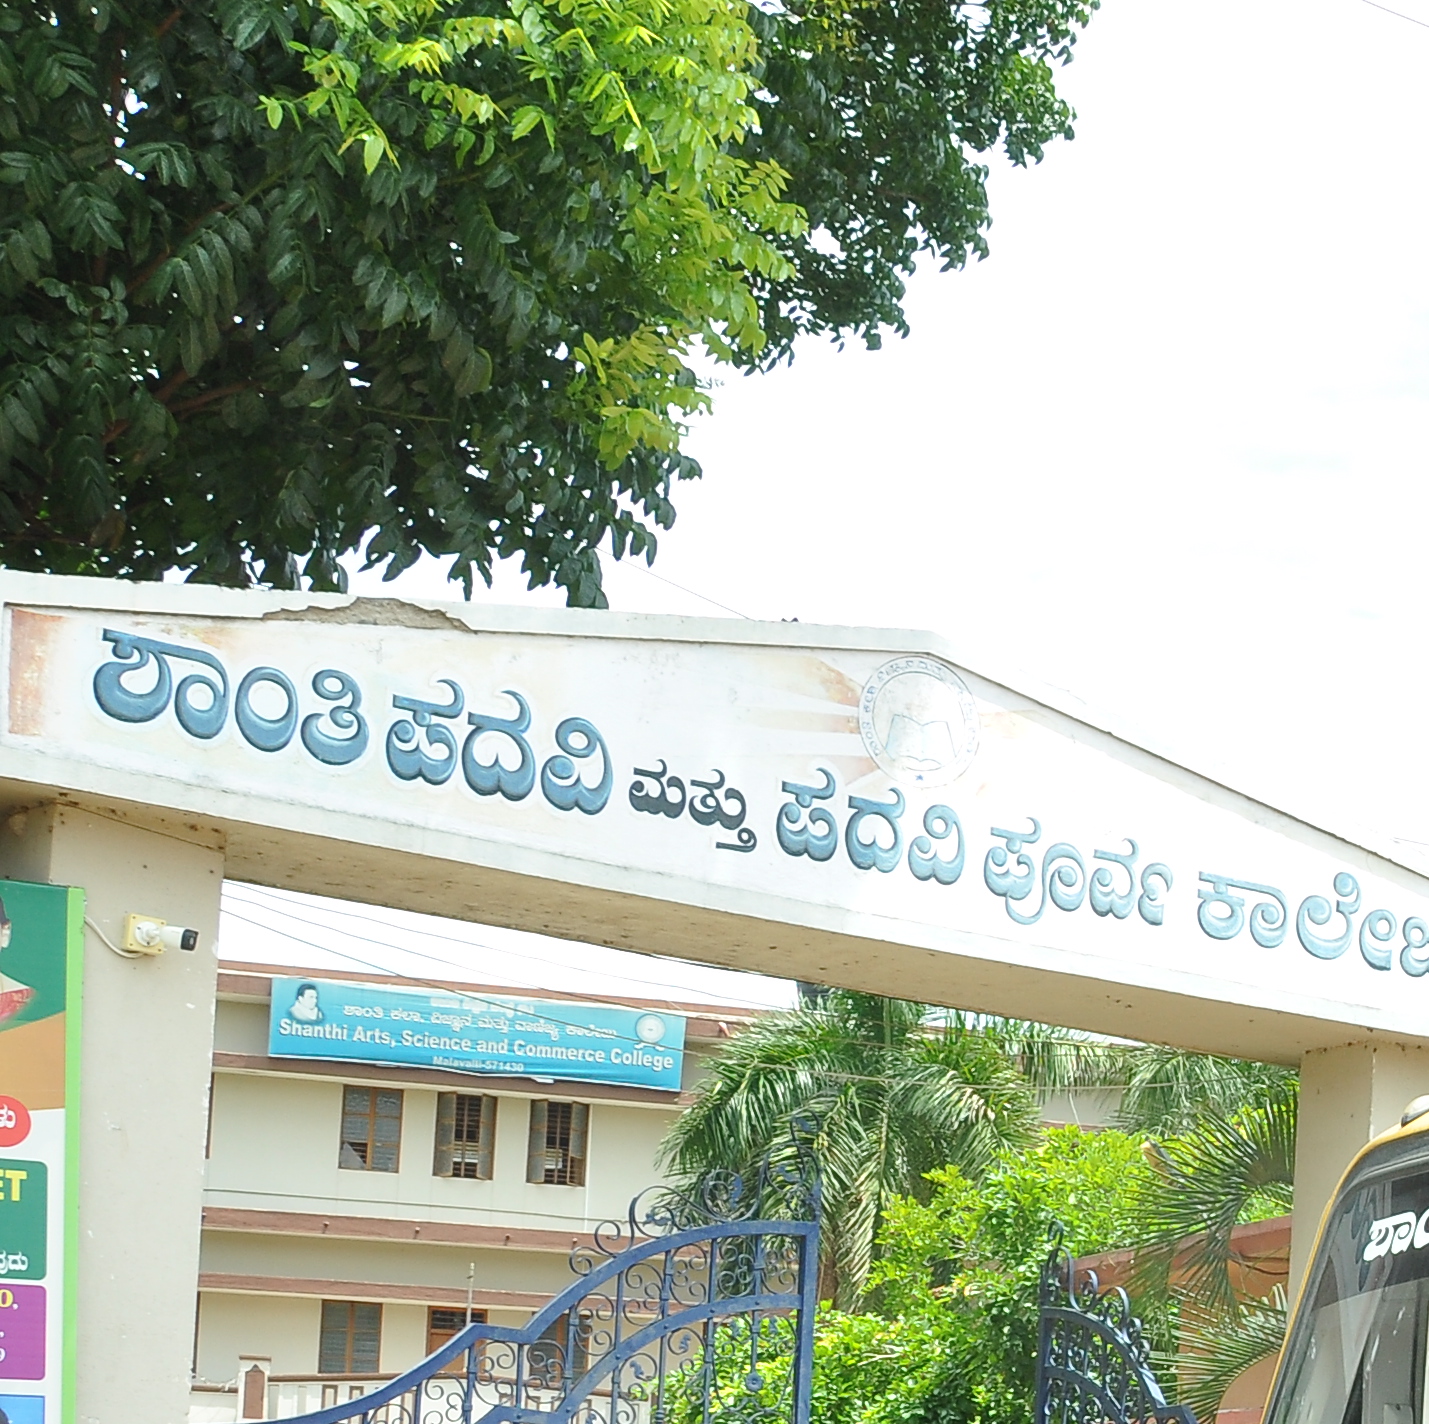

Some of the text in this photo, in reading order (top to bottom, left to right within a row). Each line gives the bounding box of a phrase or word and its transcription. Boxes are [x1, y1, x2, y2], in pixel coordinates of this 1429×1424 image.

[93, 629, 370, 766] ಶಾಂತಿ
[386, 679, 614, 816] ಪದವಿ
[628, 758, 758, 853] ಮತ್ತು
[776, 766, 966, 885] ಪದವಿ
[983, 816, 1174, 927] ಪೂರ್ವ
[342, 1004, 385, 1019] ಶಾಂತಿ
[278, 1018, 674, 1071] Shanthi Arts, Science and Commerce College
